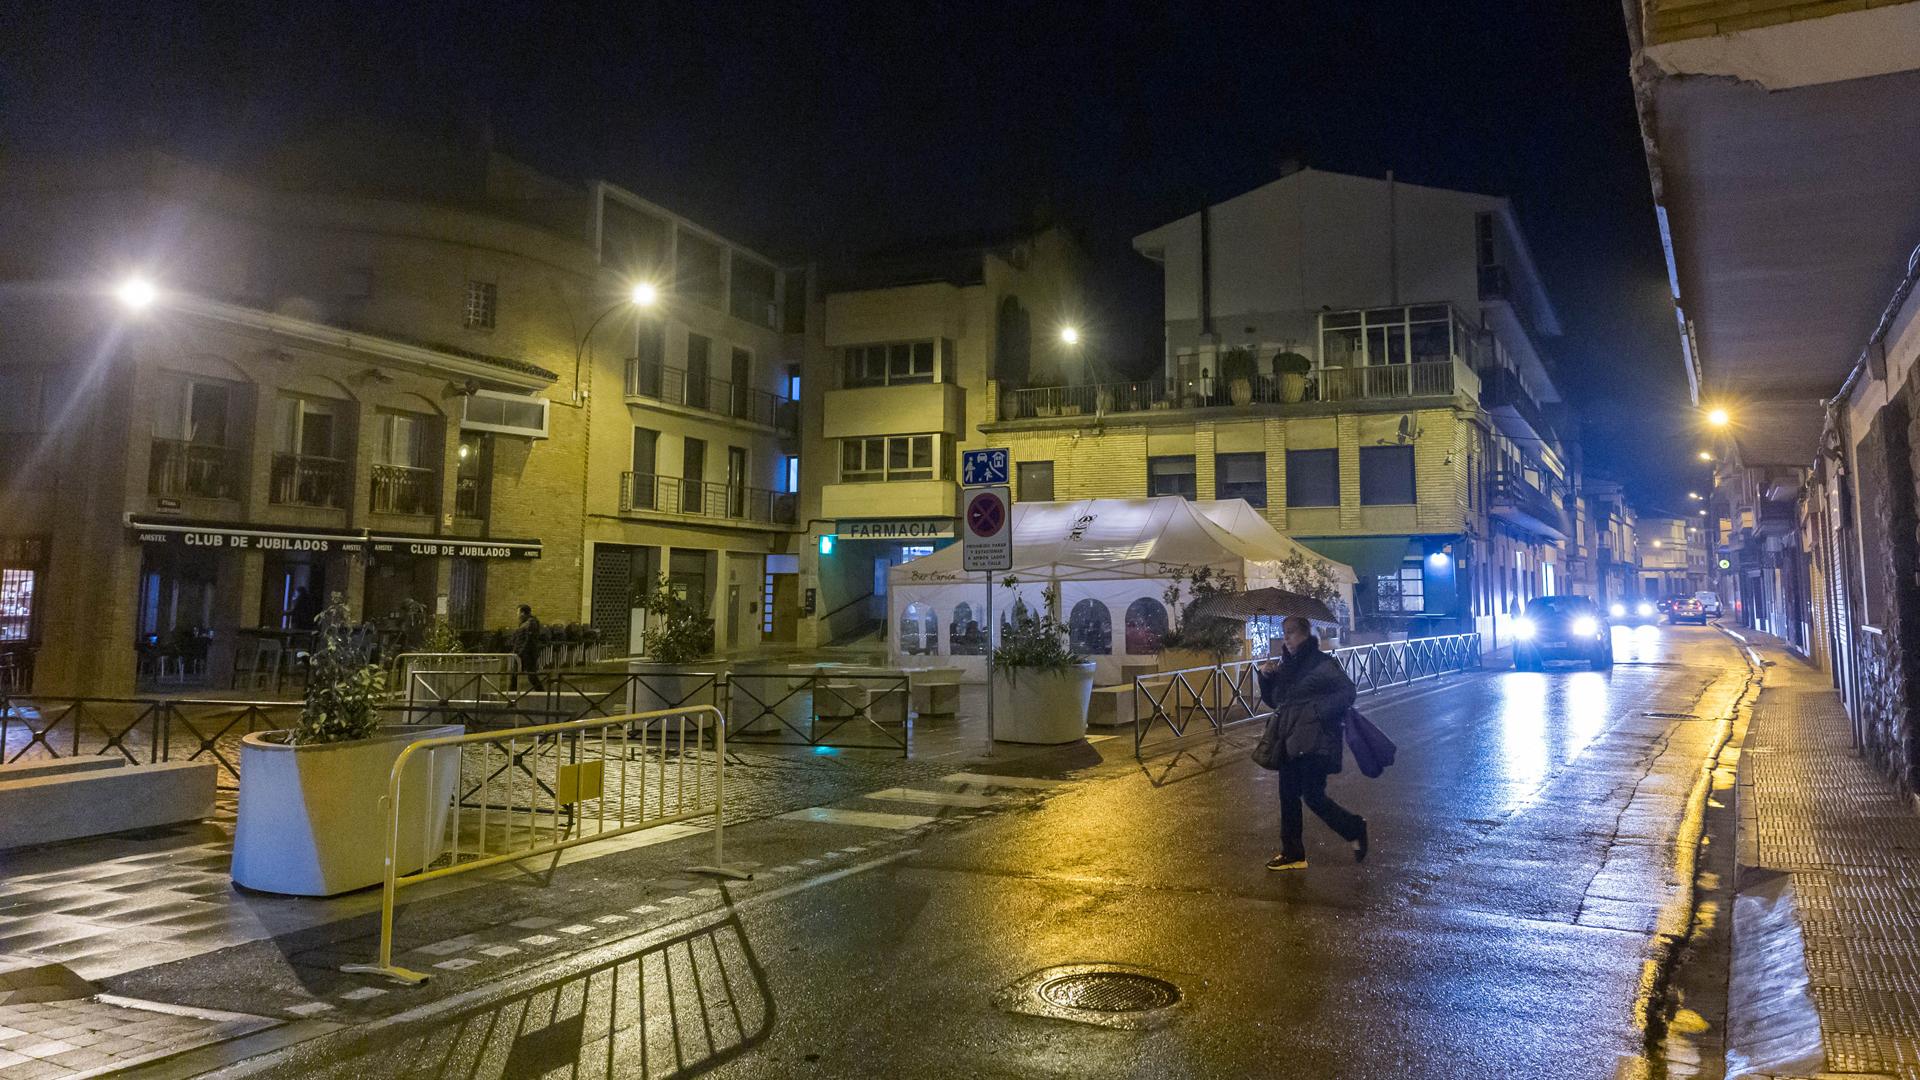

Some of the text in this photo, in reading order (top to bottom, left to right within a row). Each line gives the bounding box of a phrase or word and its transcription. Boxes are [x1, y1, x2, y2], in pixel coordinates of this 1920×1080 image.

[850, 523, 938, 537] FARMACIA
[139, 534, 167, 542] AMSTEL
[184, 533, 329, 551] CLUB DE JUBILADOS
[410, 544, 511, 557] CLUB DE JUBILADOS
[911, 570, 929, 581] Bar
